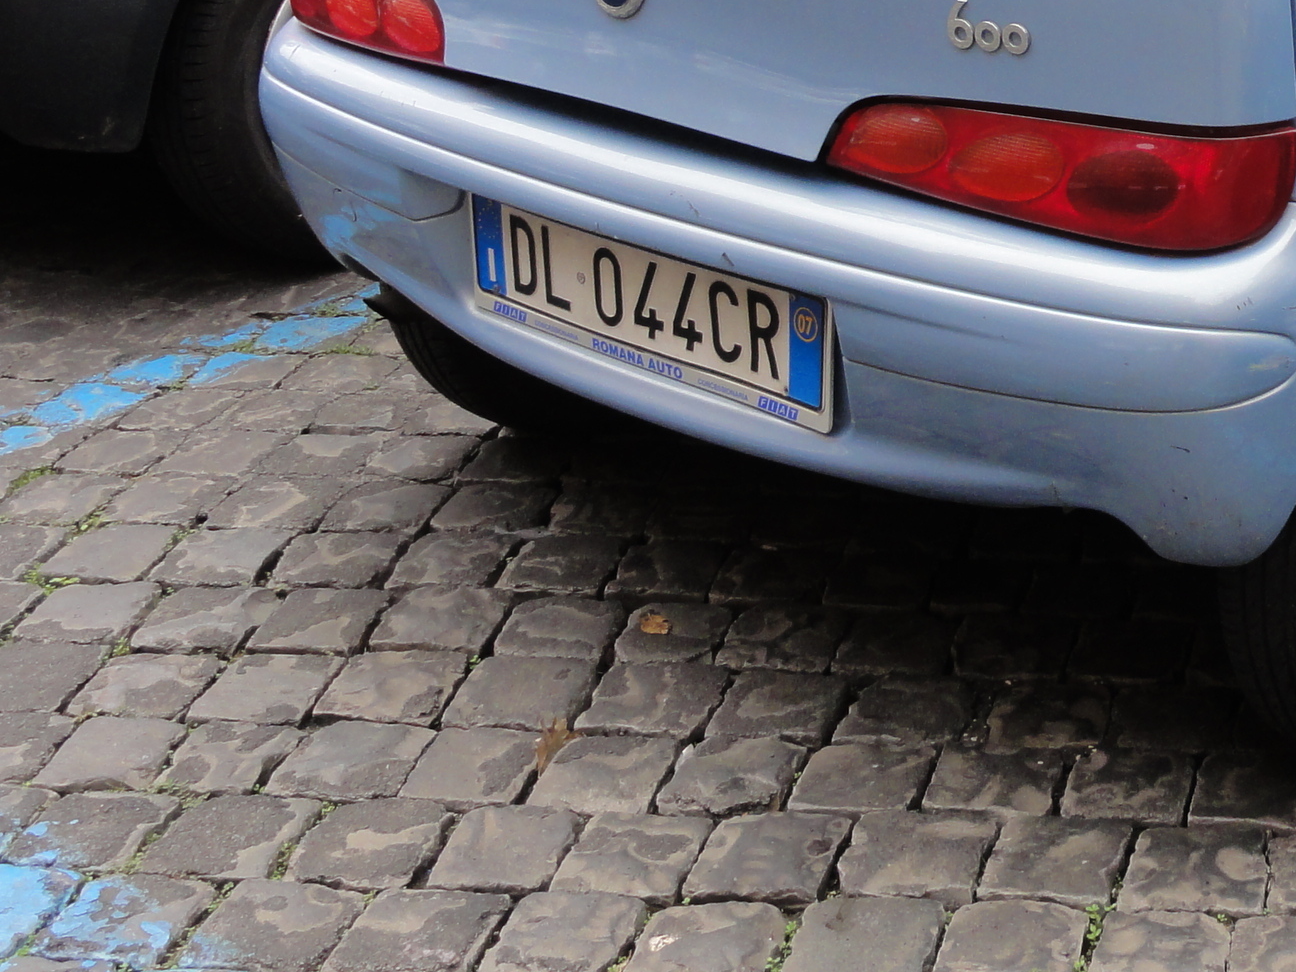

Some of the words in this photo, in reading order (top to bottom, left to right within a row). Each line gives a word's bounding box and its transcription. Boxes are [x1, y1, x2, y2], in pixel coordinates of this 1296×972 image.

[487, 247, 497, 282] I
[509, 214, 571, 313] DL
[593, 246, 780, 380] 044CR
[494, 301, 527, 322] FIAT
[592, 338, 644, 367] ROMANA
[648, 358, 683, 380] AUTO
[758, 396, 799, 421] FIAT
[797, 314, 813, 335] 07
